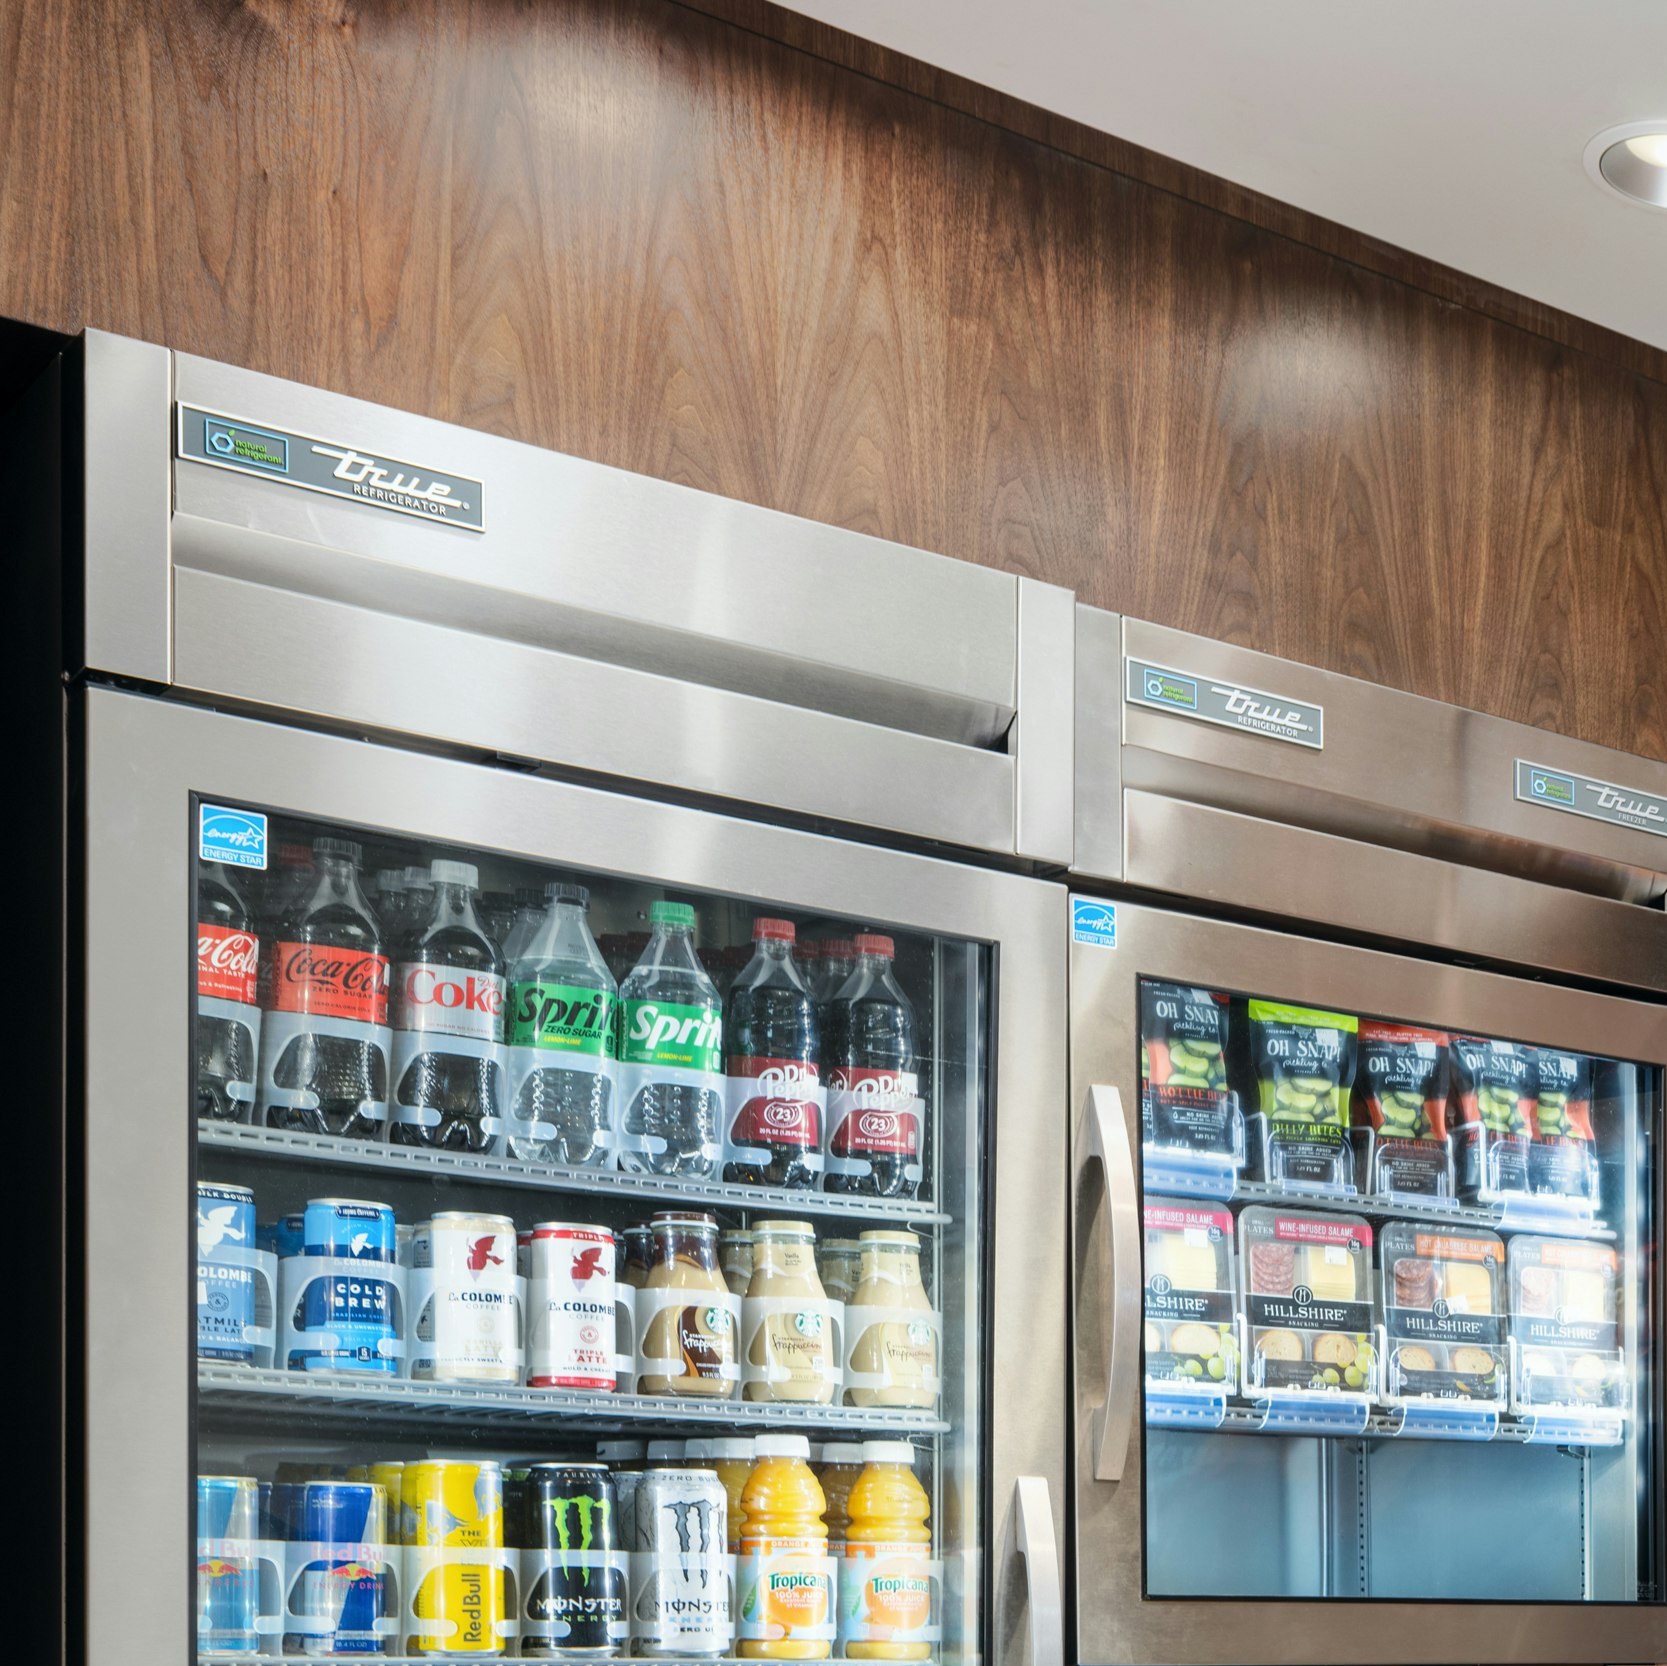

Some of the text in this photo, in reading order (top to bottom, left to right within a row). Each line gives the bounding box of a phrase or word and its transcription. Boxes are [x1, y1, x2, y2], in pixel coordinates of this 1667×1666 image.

[235, 438, 267, 453] natural
[311, 446, 462, 509] true
[353, 483, 447, 516] REFRIGERATOR
[1211, 687, 1309, 731] true
[1237, 715, 1298, 738] REFRIGERATOR
[1586, 784, 1666, 822] true
[1618, 812, 1648, 827] FREEZER
[203, 848, 262, 866] ENERGY STAR
[286, 948, 388, 997] Coca-Cola
[311, 985, 374, 1001] ZERO SUGAR
[406, 968, 503, 1014] Coke
[1155, 1001, 1178, 1020] OH
[544, 1024, 602, 1040] ZERO SUGAR
[1173, 1022, 1206, 1036] pickling
[656, 1052, 693, 1063] LEMON-LIME
[1266, 1039, 1342, 1063] OH SNAP!
[1282, 1058, 1319, 1075] pickling
[1368, 1056, 1437, 1078] OH SNAP!
[1466, 1054, 1529, 1077] OH SNAP!
[776, 1107, 791, 1121] 23
[871, 1117, 886, 1131] 23
[1271, 1122, 1343, 1138] DILLY BITES
[1186, 1213, 1214, 1226] SALAME
[1278, 1221, 1354, 1238] WINE-INFUSED SALAME
[1384, 1240, 1416, 1252] PLATES
[336, 1283, 385, 1295] COLD
[335, 1297, 387, 1310] BREW
[1263, 1303, 1344, 1322] HILLSHIRE
[1288, 1319, 1319, 1329] SNACKING
[1405, 1316, 1482, 1334] HILLSHIRE
[1530, 1323, 1598, 1341] HILLSHIRE
[1428, 1332, 1458, 1340] SNACKING
[573, 1348, 604, 1356] TRIPLE
[661, 1473, 693, 1483] ZERO
[460, 1528, 482, 1538] THE
[768, 1572, 827, 1593] Tropicana
[871, 1575, 929, 1596] Tropicana
[536, 1596, 623, 1614] MONSTER
[774, 1591, 824, 1602] 100% JUICE
[463, 1572, 482, 1643] Red Bull
[550, 1614, 619, 1624] ENERGY
